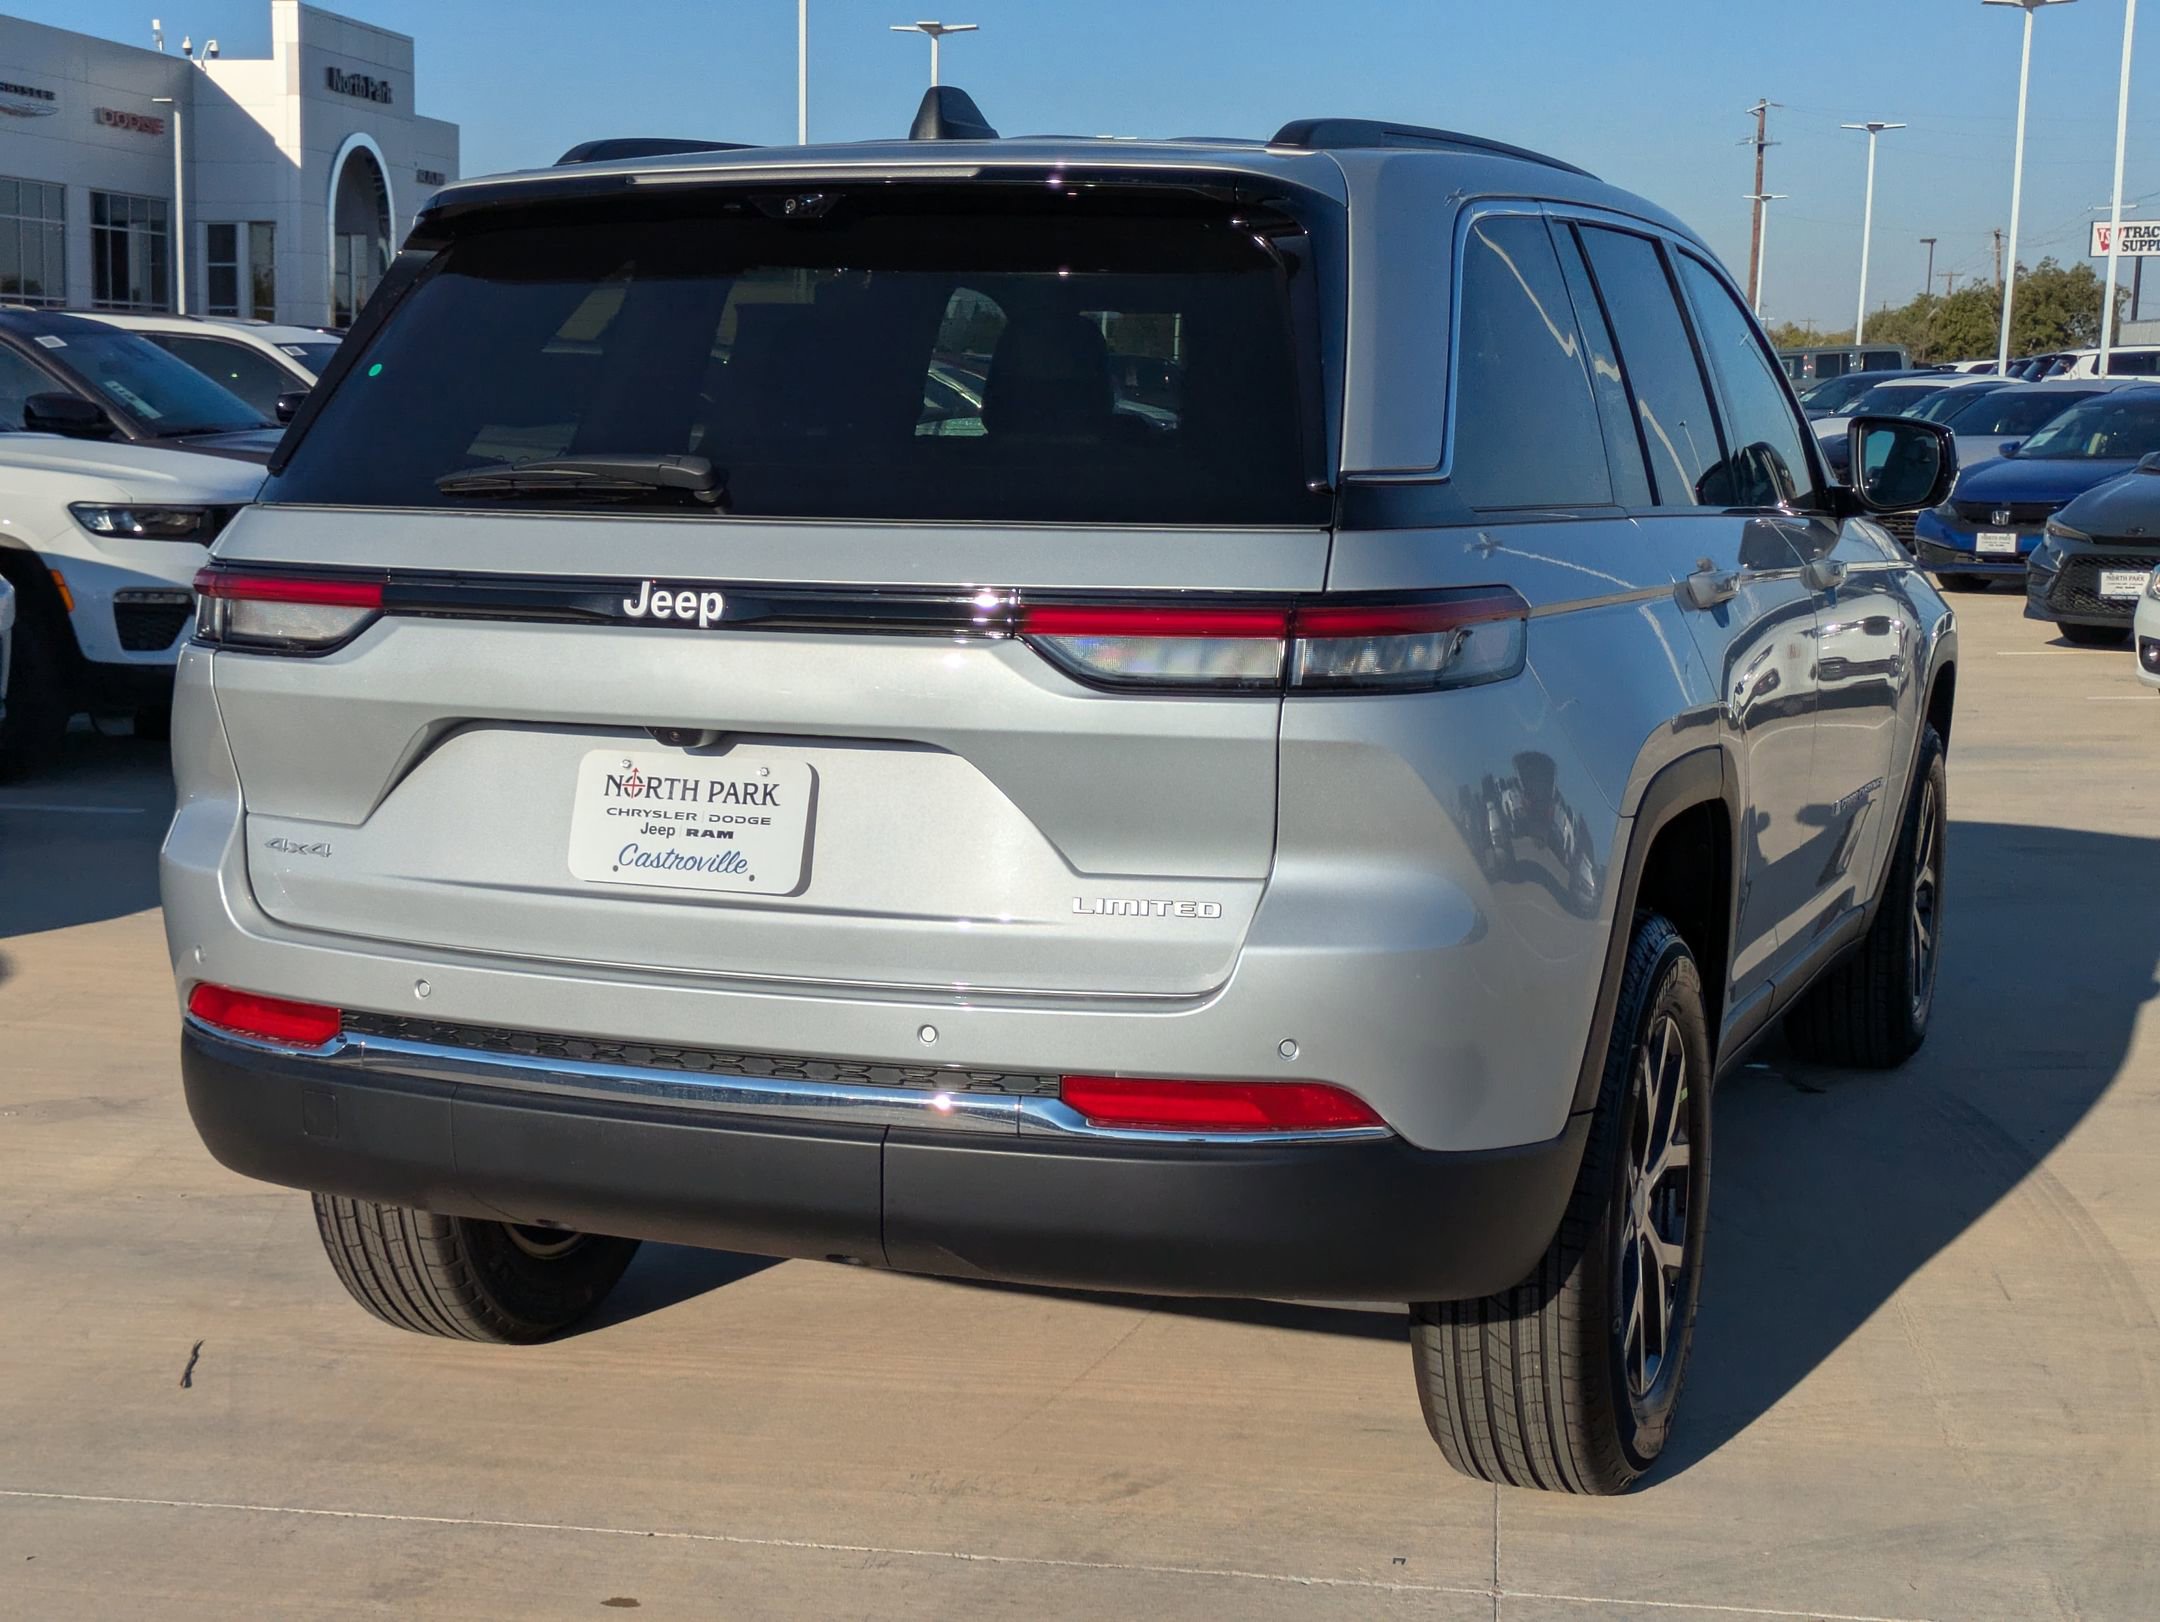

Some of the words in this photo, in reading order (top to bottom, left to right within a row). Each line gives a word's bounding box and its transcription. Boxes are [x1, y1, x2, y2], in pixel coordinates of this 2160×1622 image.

[327, 67, 366, 98] North
[367, 76, 393, 104] Park
[95, 107, 164, 135] DODGE
[622, 580, 725, 629] Jeep
[603, 772, 699, 802] NORTH
[707, 780, 781, 807] PARK
[606, 807, 697, 821] CHRYSLER
[708, 814, 772, 826] DODGE
[640, 822, 676, 838] Jeep
[685, 828, 734, 840] RAM
[264, 837, 332, 858] 4x4
[618, 843, 748, 875] Castroville
[1071, 897, 1222, 919] LIMITED
